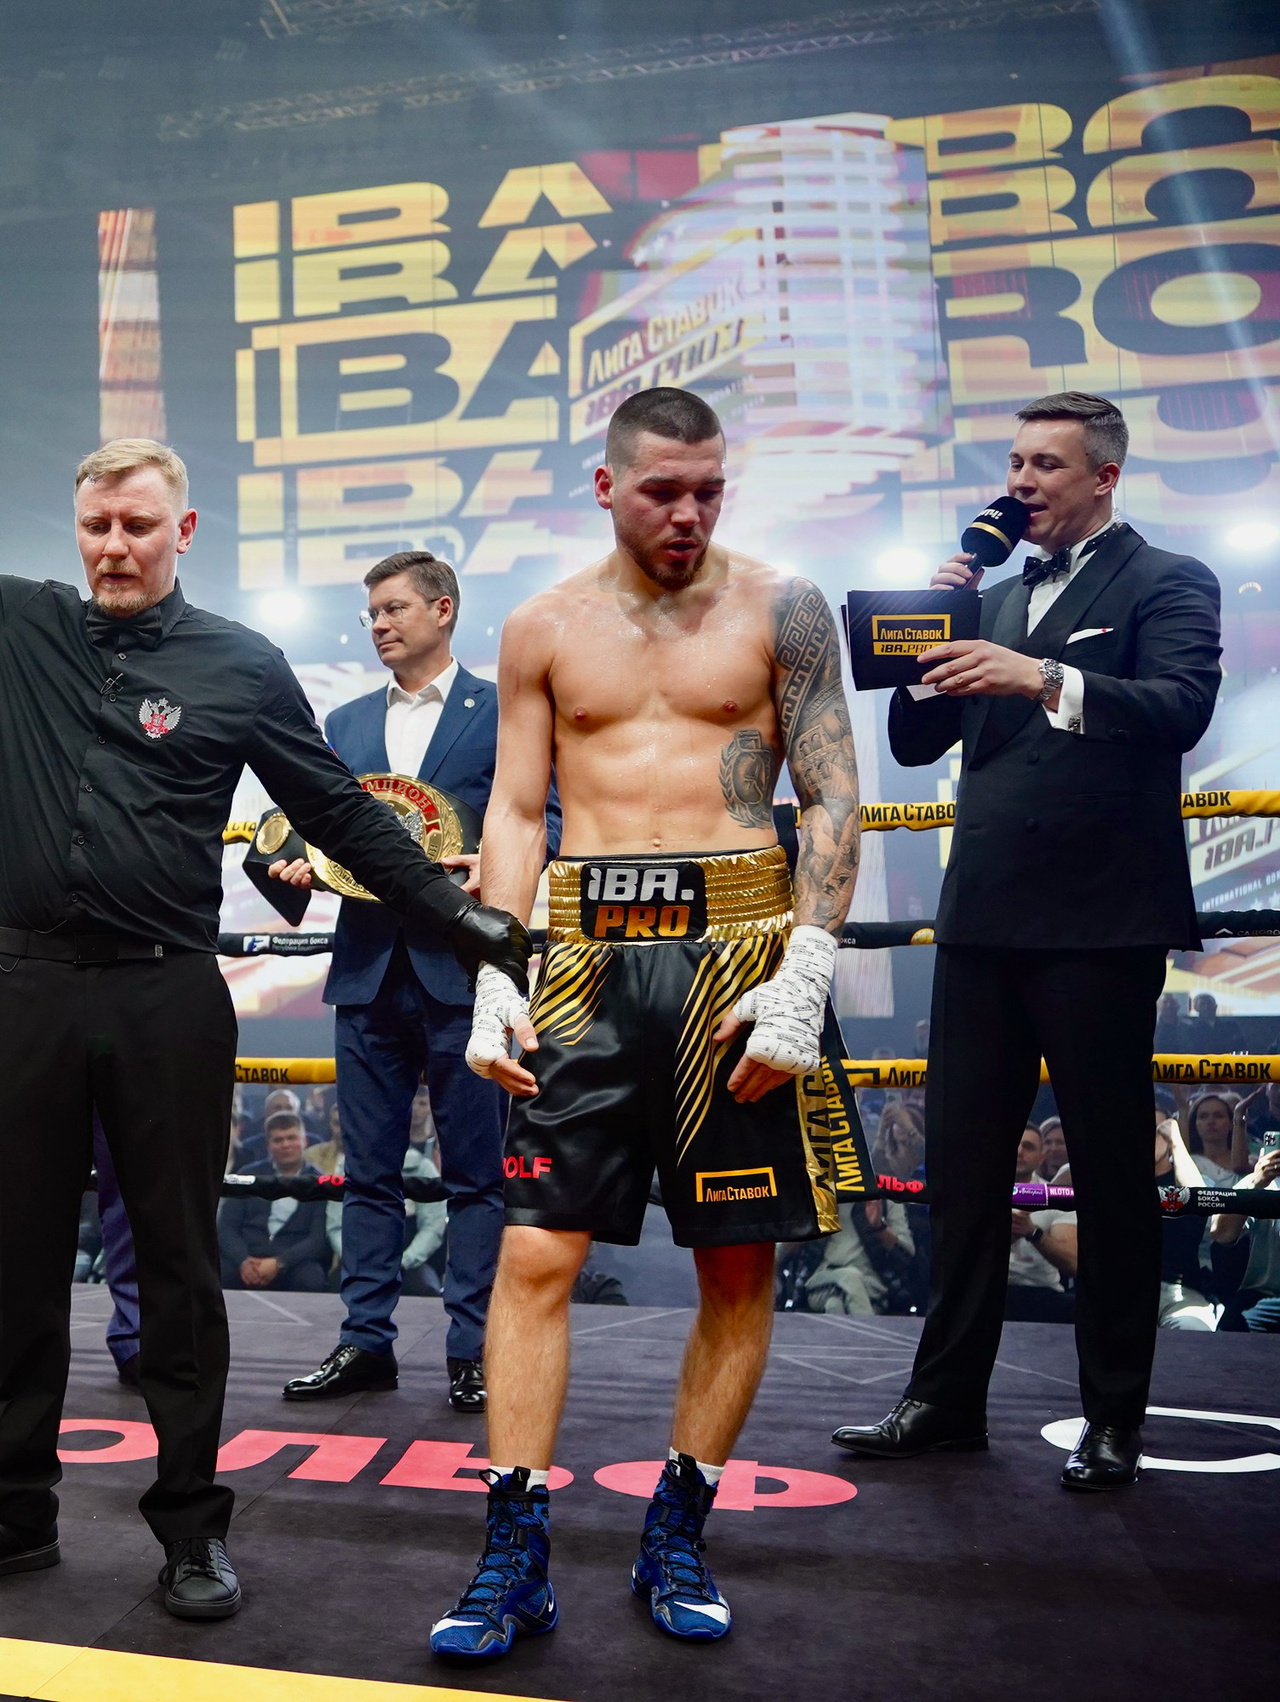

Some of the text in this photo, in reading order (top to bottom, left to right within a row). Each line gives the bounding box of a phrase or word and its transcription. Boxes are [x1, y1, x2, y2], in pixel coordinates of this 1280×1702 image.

[880, 628, 943, 640] ЛИГА СТАВОК
[1182, 791, 1232, 809] АВОК
[860, 805, 901, 823] ЛИГА
[1202, 878, 1262, 912] INTERNATIONAL
[594, 905, 691, 938] PRO
[235, 1064, 289, 1083] СТАВОК
[886, 1067, 927, 1086] ЛИГА
[1151, 1059, 1271, 1080] ЛИГА СТАВОК
[832, 1137, 865, 1192] ЛИГА
[706, 1185, 770, 1202] ЛИГА СТАВОК
